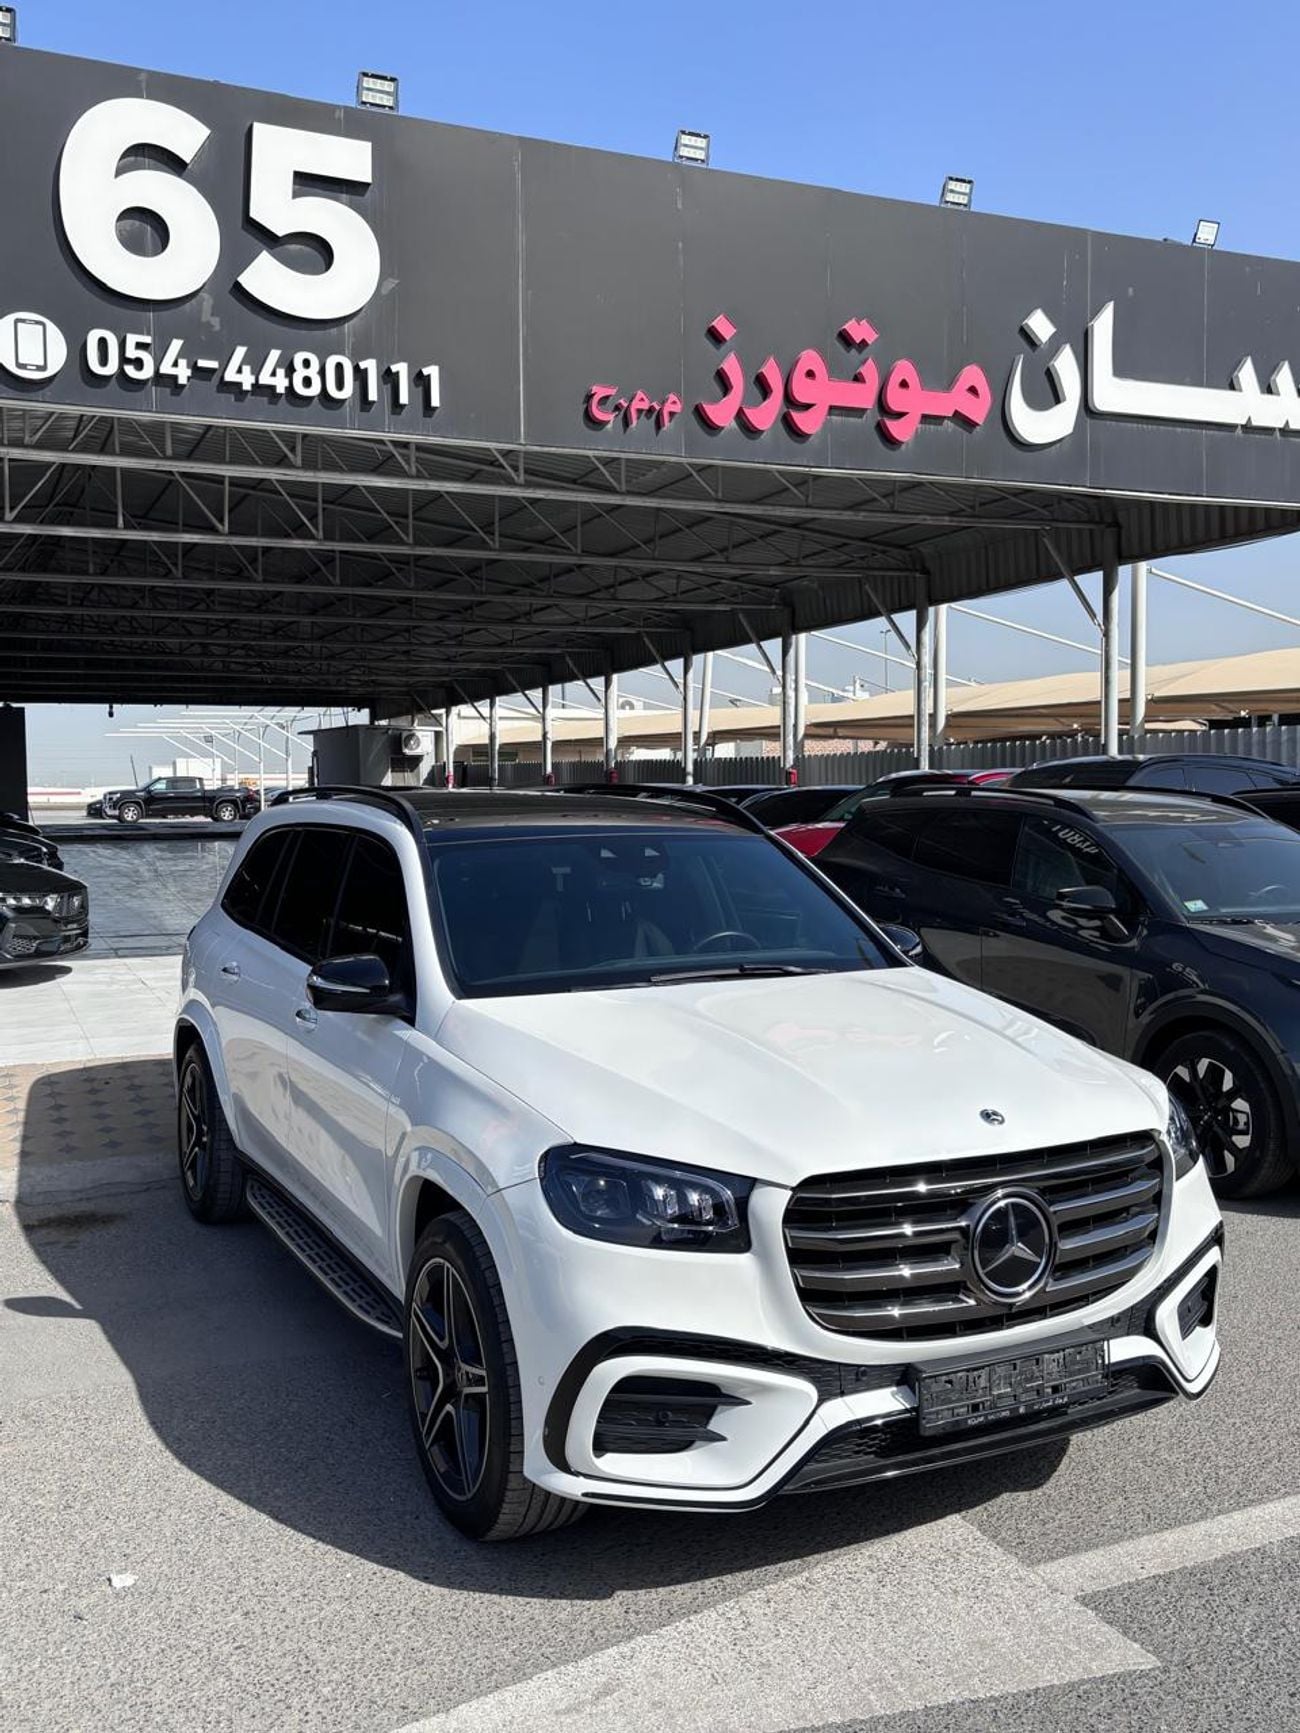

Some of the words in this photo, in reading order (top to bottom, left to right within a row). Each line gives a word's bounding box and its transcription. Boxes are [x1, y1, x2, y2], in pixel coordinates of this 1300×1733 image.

[58, 96, 382, 320] 65
[85, 328, 440, 408] 054-4480111
[699, 313, 992, 443] موتورز
